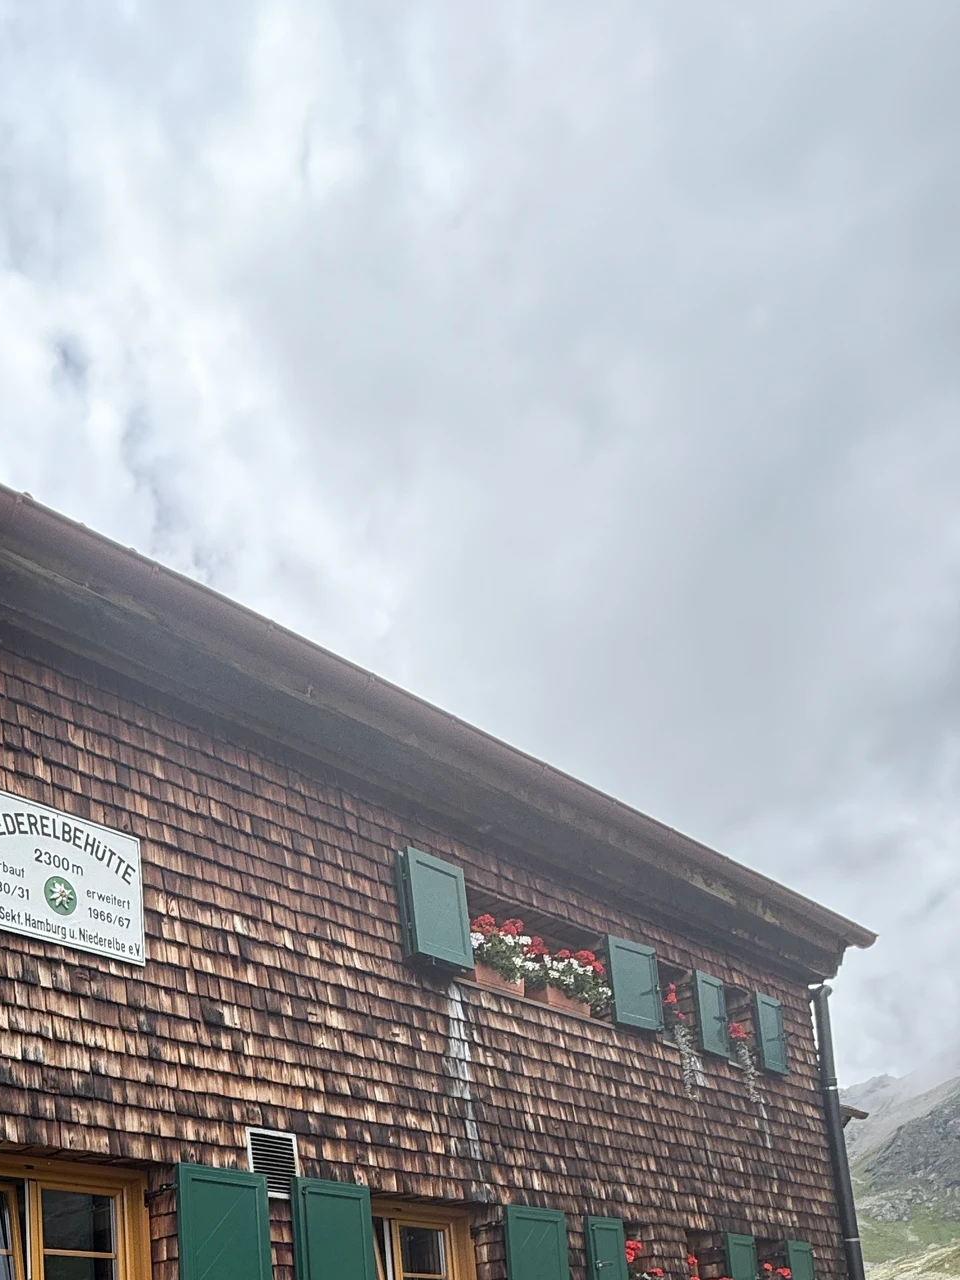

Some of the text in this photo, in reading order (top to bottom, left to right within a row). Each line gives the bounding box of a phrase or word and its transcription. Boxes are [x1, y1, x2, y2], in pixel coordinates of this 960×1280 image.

[86, 889, 130, 909] erweitert
[88, 906, 131, 929] 1966/67
[24, 911, 67, 940] Hamburg
[69, 928, 78, 939] u.
[79, 927, 125, 952] Niederelbe
